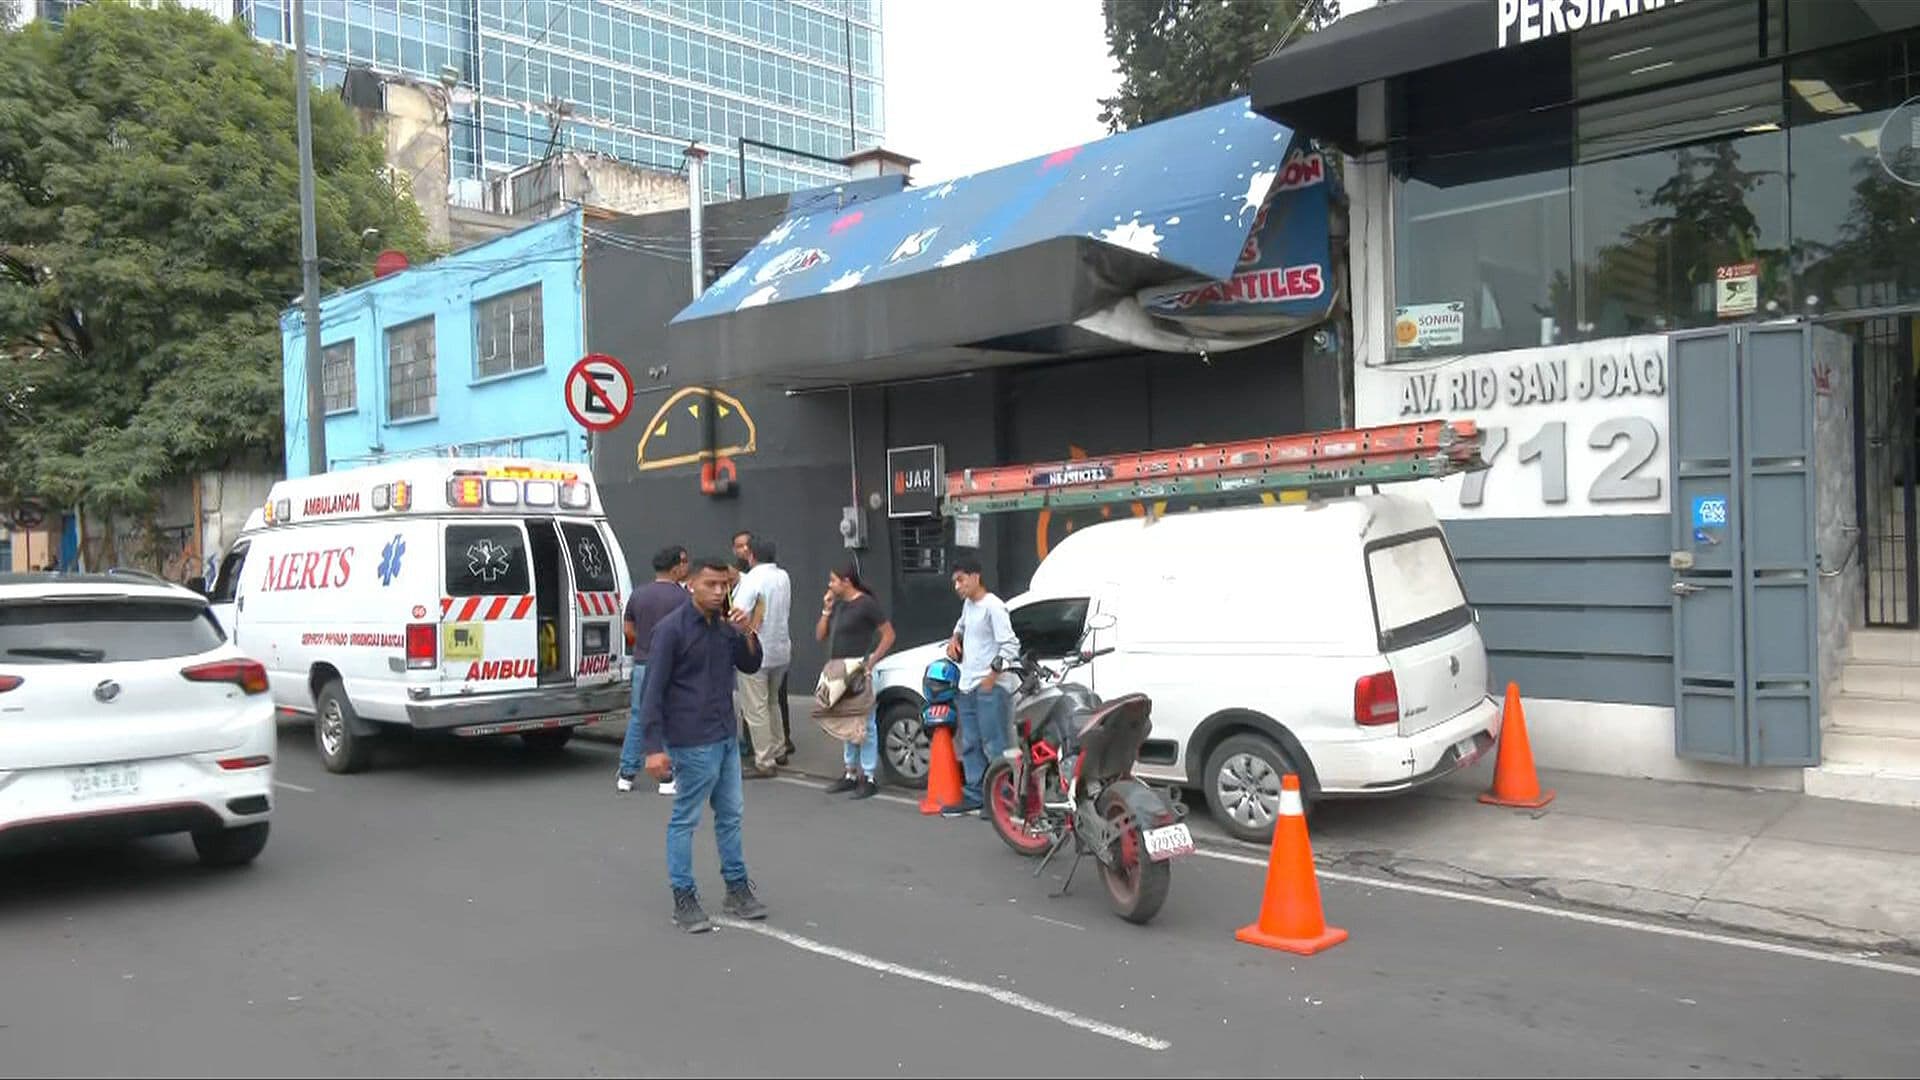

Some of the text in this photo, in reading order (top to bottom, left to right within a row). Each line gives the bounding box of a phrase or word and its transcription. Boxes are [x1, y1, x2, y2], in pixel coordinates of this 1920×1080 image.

[1498, 0, 1684, 47] PERSIA
[1400, 352, 1666, 416] AV. RIO SAN JOAQ
[302, 492, 360, 516] AMBULANCIA
[261, 546, 355, 593] MERTS
[465, 655, 610, 682] AMBUL ANCIA
